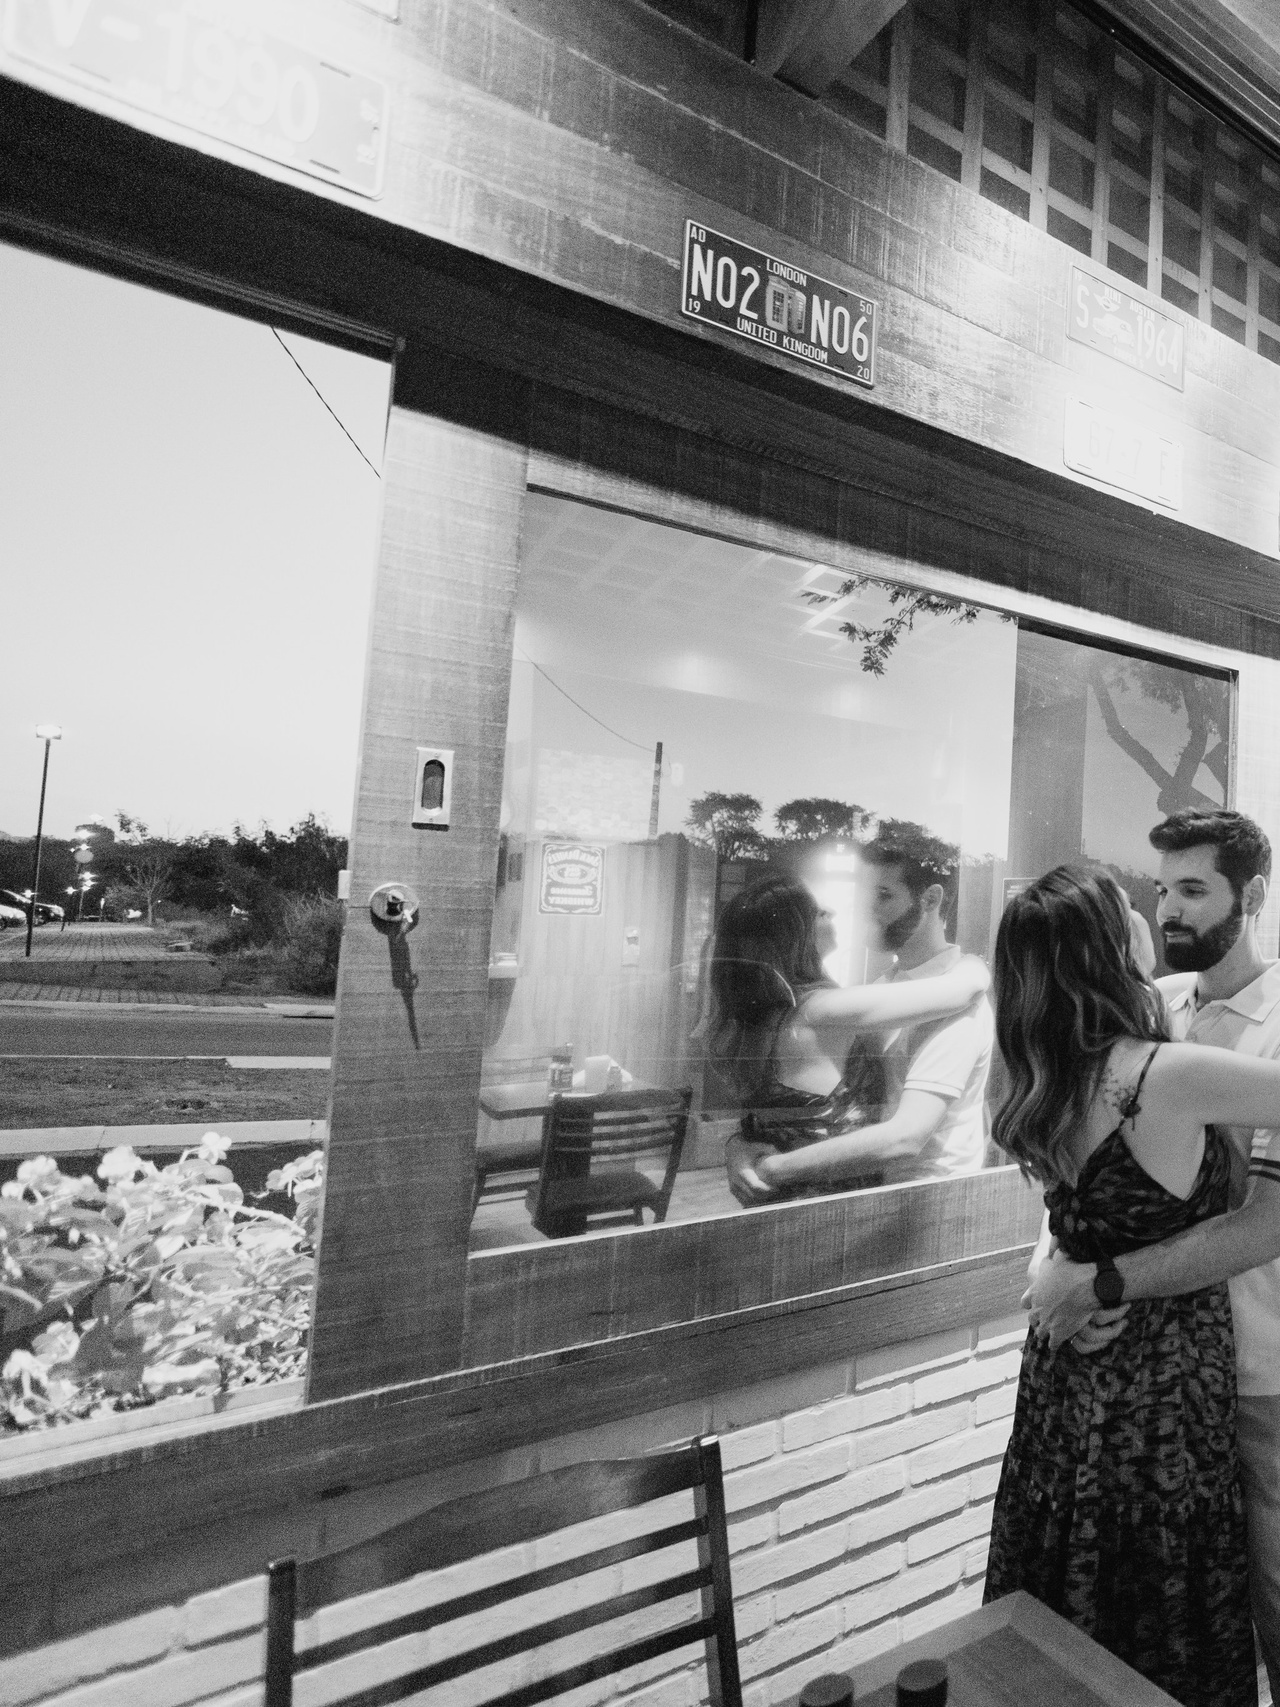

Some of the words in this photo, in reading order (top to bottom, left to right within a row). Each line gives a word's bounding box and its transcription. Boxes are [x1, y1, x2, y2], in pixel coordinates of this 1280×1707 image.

[766, 258, 807, 287] LONDON
[688, 298, 701, 313] 19
[859, 300, 872, 315] 50
[1129, 299, 1155, 322] AUSTIN
[737, 316, 777, 344] UNITED
[783, 335, 828, 364] KINGDOM
[1076, 284, 1090, 329] S
[1136, 314, 1179, 374] 1964
[857, 365, 870, 380] 20
